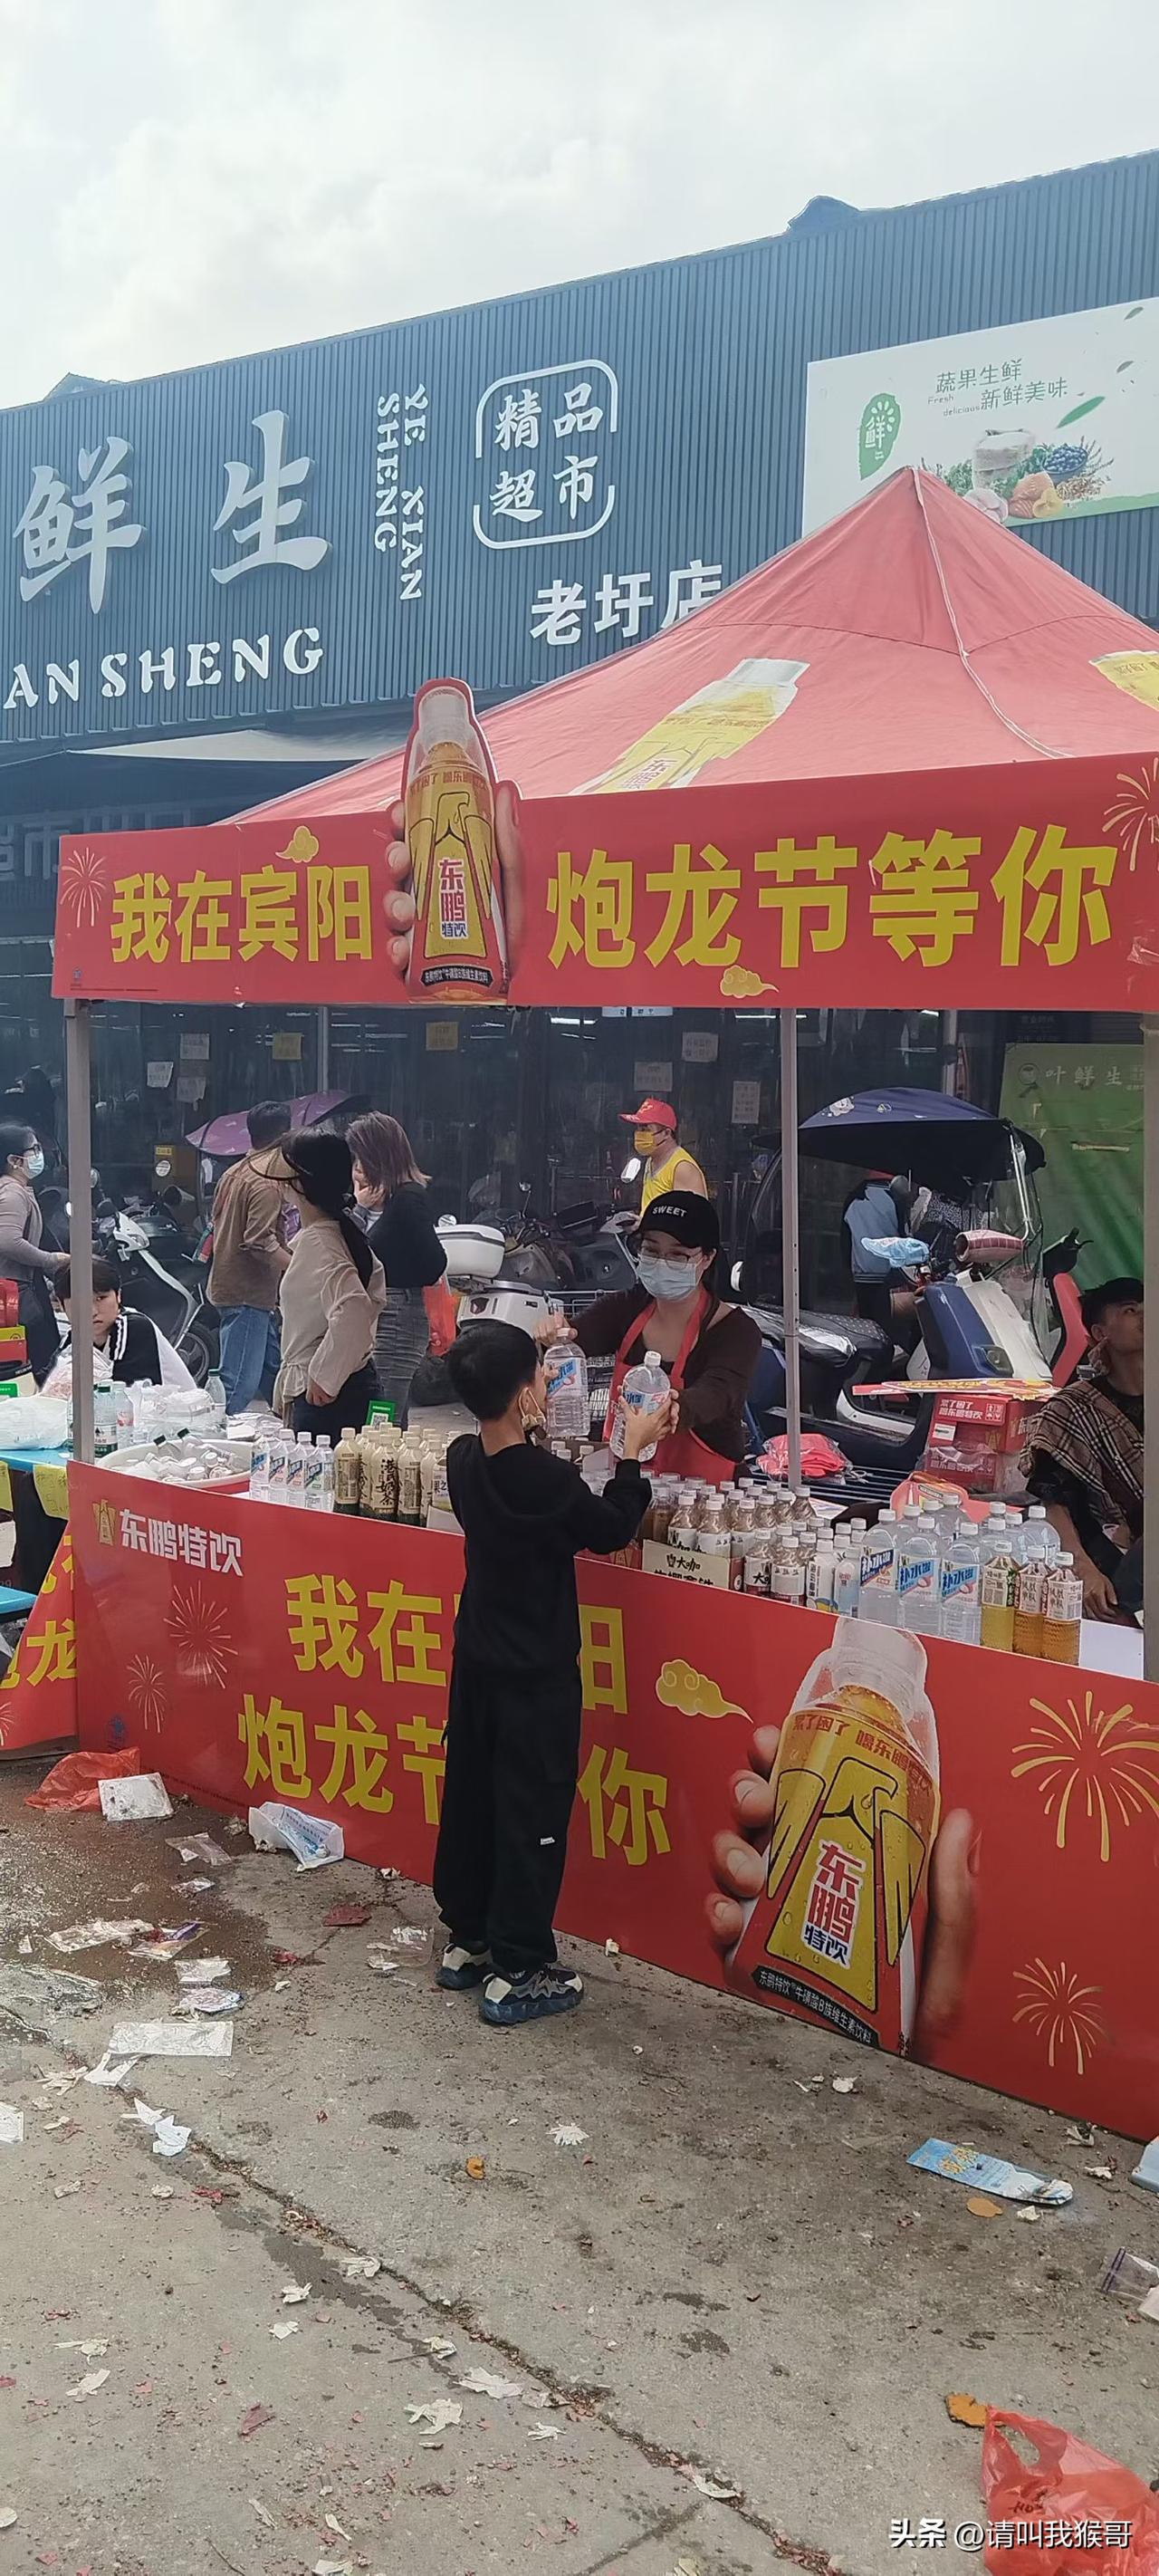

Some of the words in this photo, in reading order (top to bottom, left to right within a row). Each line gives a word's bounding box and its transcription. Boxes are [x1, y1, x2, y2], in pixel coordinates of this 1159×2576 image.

[927, 395, 954, 405] Fresh
[935, 358, 1022, 394] 蔬果生鲜
[981, 376, 1068, 409] 新鲜美味
[404, 383, 429, 447] YE
[493, 381, 604, 451] 精品
[943, 405, 986, 417] delicious
[373, 392, 401, 553] SHENG
[489, 455, 599, 523] 超市
[13, 409, 334, 616] 鲜生
[398, 485, 426, 601] XIAN
[530, 559, 723, 646] 老圩店
[110, 864, 373, 965] 我在宾阳
[546, 823, 1119, 970] 炮龙节等你
[1045, 1065, 1123, 1088] 叶鲜生
[652, 1205, 688, 1218] SWEET
[119, 1509, 244, 1577] 东鹏特饮
[237, 1693, 671, 1867] 炮龙节你
[803, 1925, 850, 1967] 特饮
